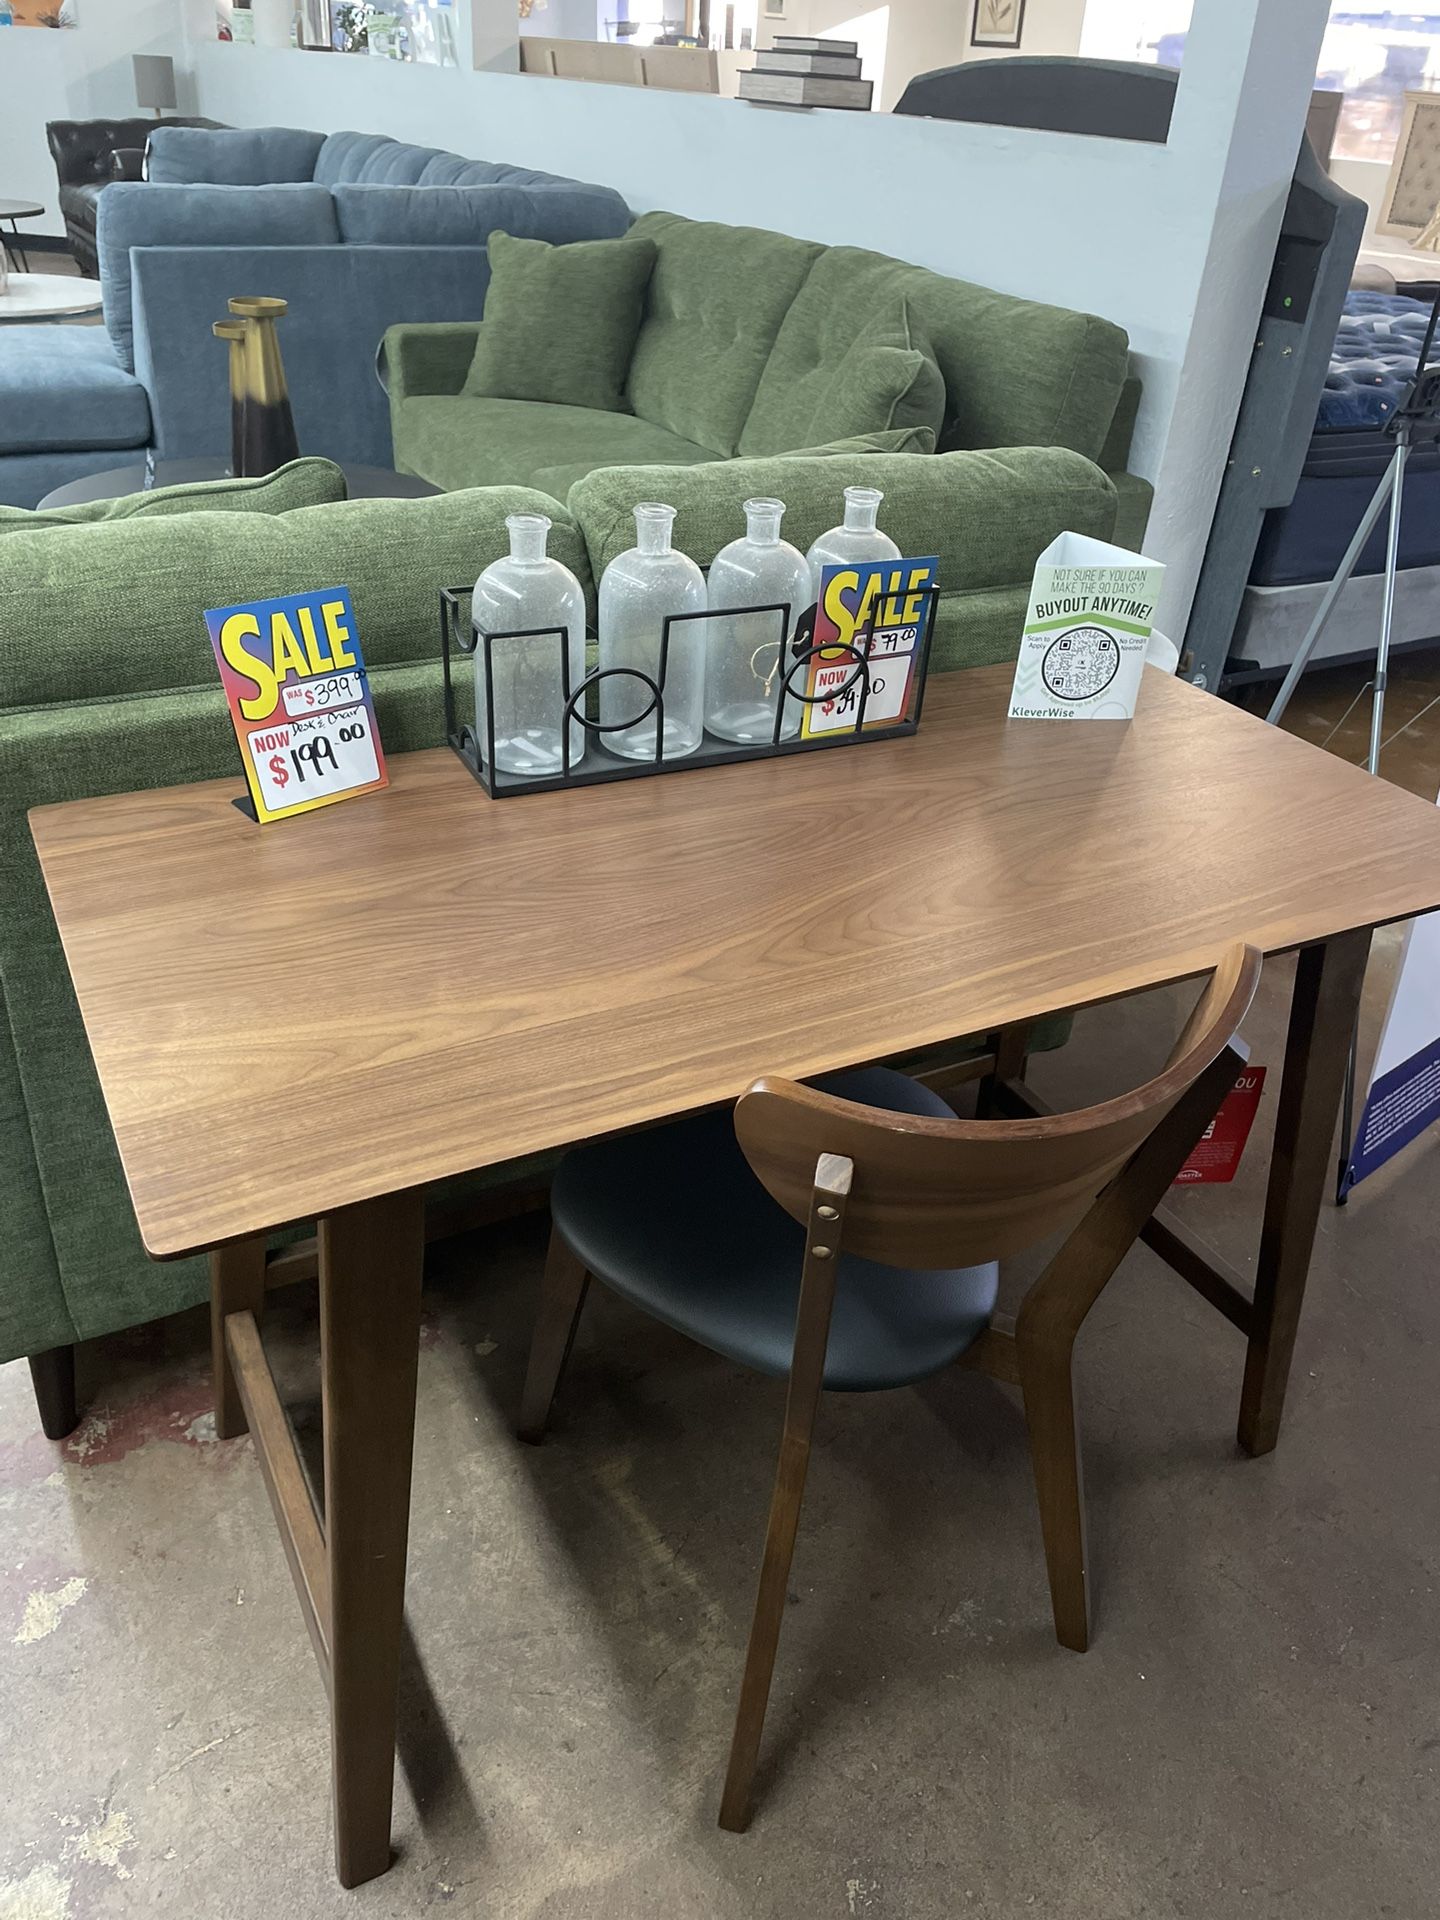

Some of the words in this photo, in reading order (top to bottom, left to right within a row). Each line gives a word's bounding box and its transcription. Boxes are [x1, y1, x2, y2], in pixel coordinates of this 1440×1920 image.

[1053, 569, 1071, 580] NOT
[1073, 569, 1097, 580] SURE
[1098, 569, 1106, 580] IF
[1109, 569, 1126, 581] YOU
[1128, 570, 1147, 581] CAN
[1051, 582, 1077, 593] MAKE
[1080, 582, 1097, 593] THE
[1098, 582, 1111, 594] 90
[819, 568, 930, 660] SALE
[1036, 596, 1089, 618] BUYOUT
[1091, 596, 1153, 620] ANYTIME!
[1028, 642, 1046, 650] Apply
[219, 600, 357, 721] SALE
[819, 669, 848, 687] NOW
[286, 687, 303, 701] WAS
[288, 719, 317, 737] Desk
[327, 704, 360, 726] Chair
[1011, 706, 1075, 718] KleverWise
[253, 730, 291, 754] NOW
